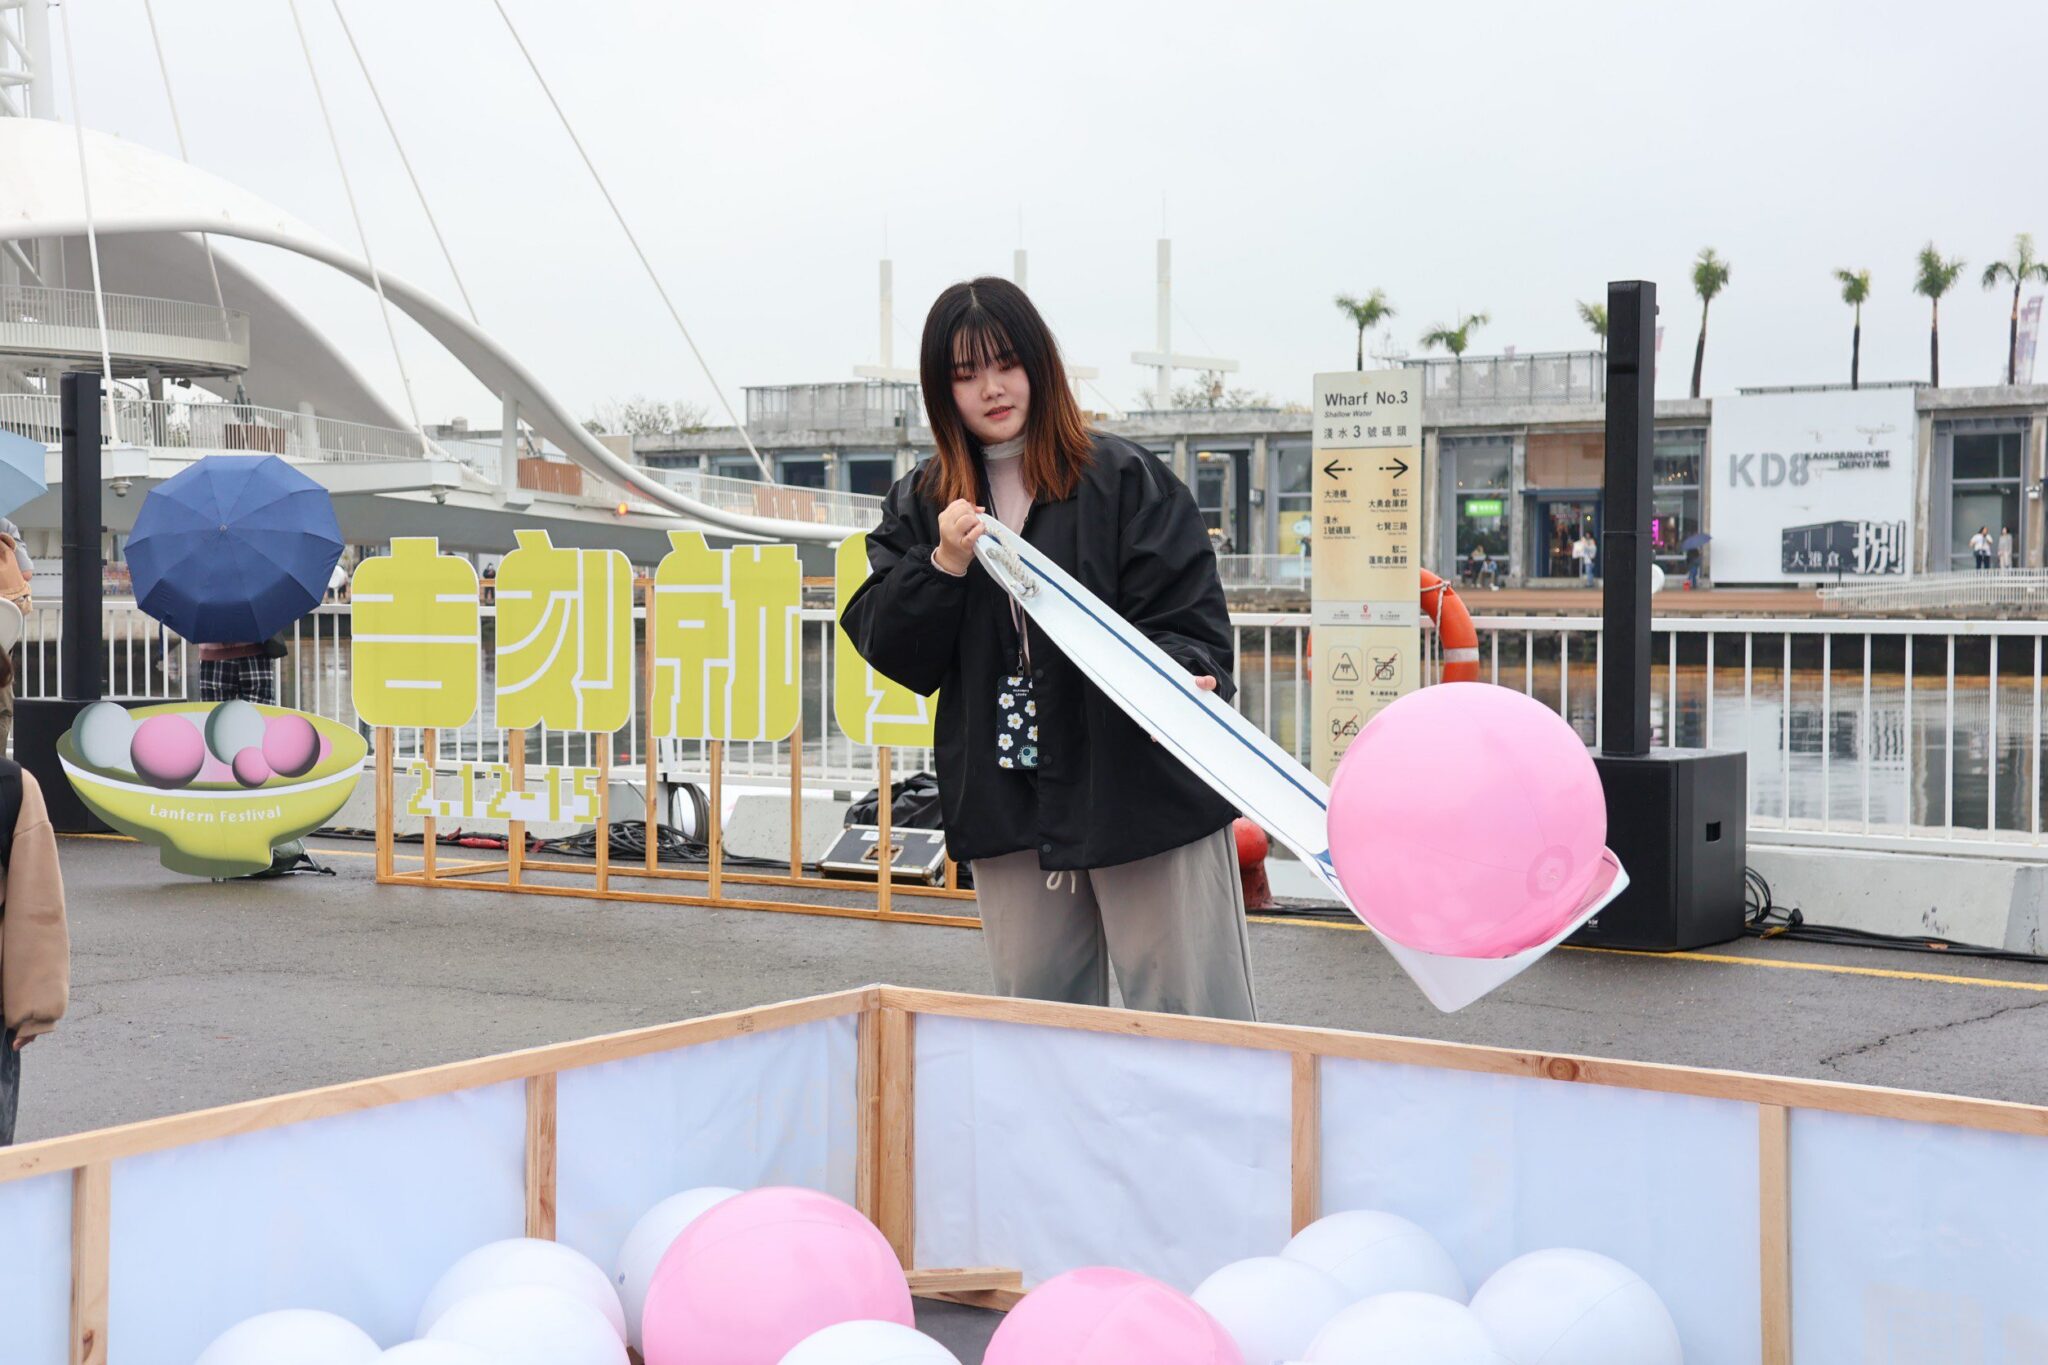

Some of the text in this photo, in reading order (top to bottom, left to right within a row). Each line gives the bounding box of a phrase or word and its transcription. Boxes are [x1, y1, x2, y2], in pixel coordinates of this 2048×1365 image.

[1325, 390, 1408, 406] Wharf No.3
[1324, 410, 1351, 418] Shallow
[1804, 450, 1890, 461] KAOHSIUNG PORT
[1729, 452, 1810, 488] KD8
[1838, 461, 1871, 469] DEPOT
[149, 803, 282, 823] Lantern Festival
